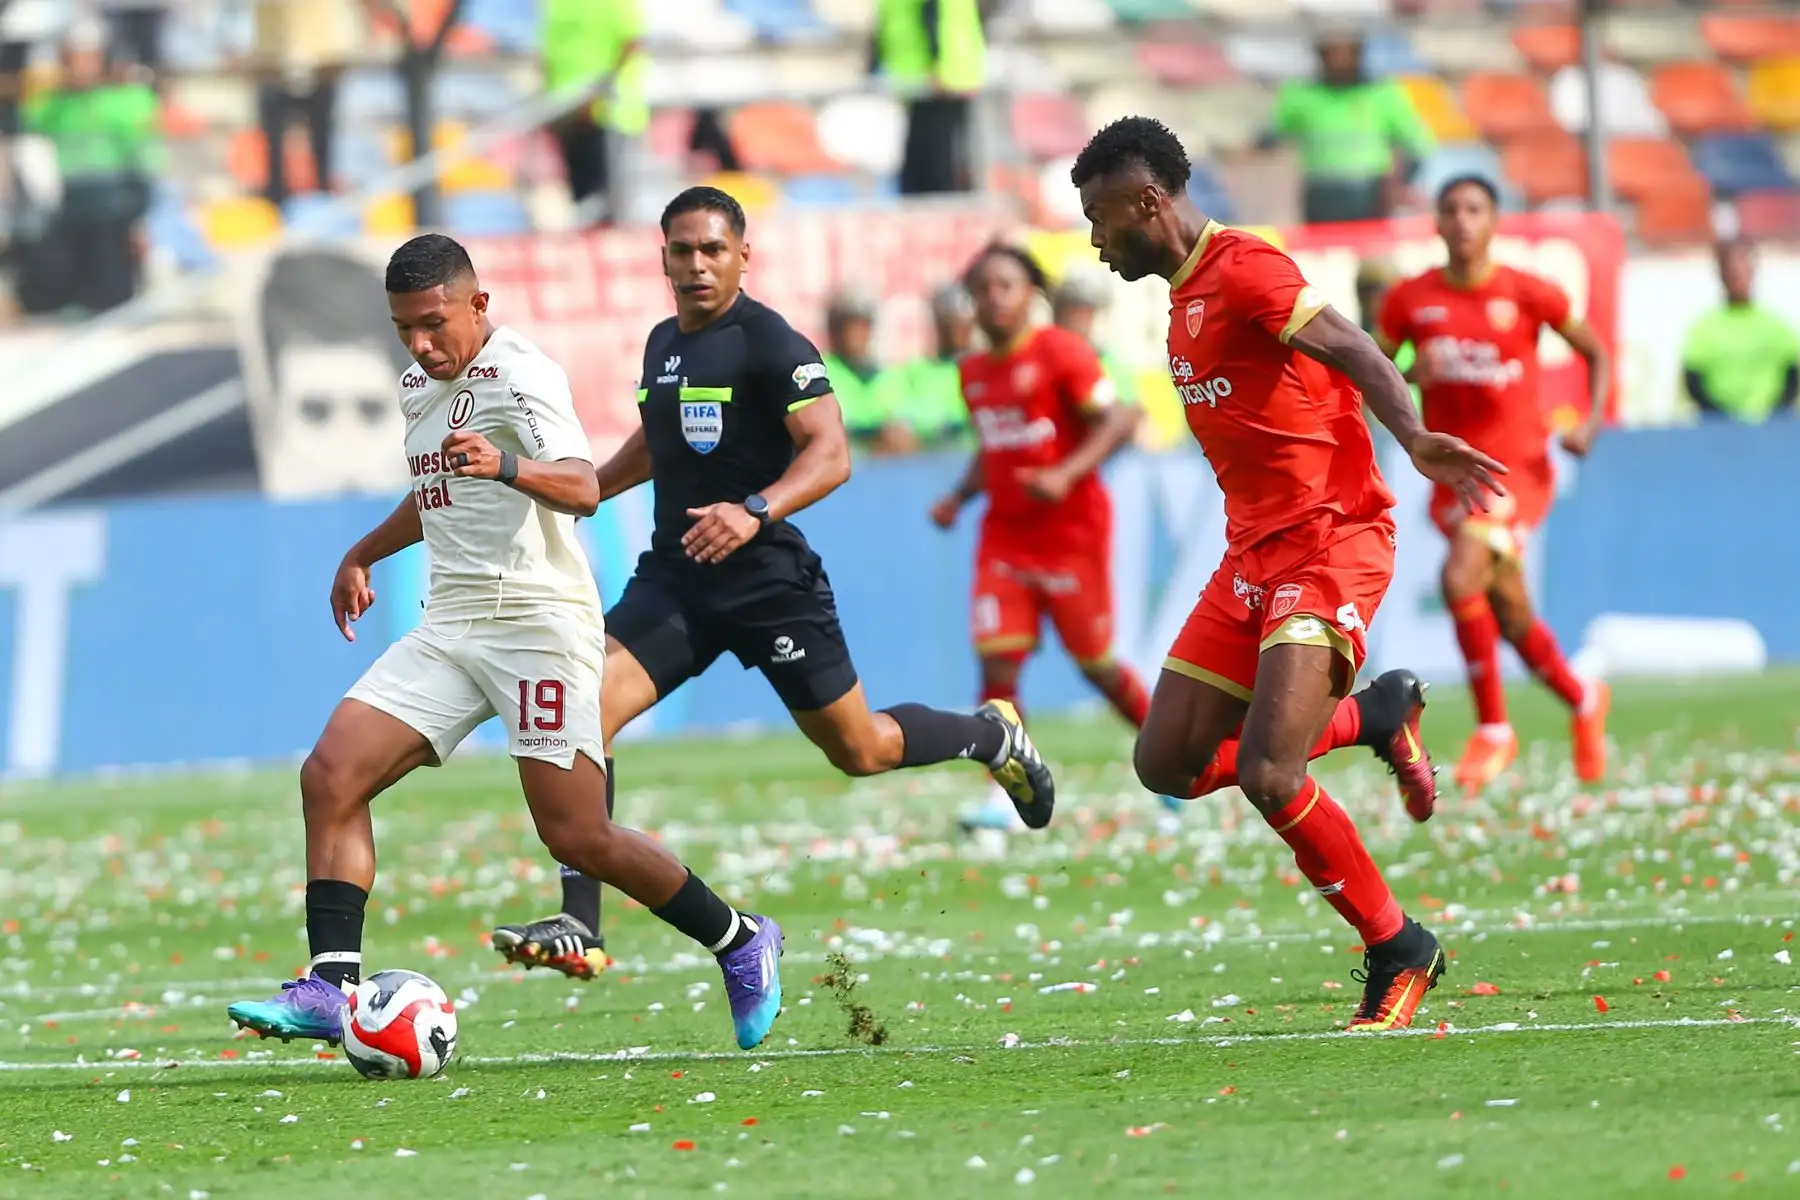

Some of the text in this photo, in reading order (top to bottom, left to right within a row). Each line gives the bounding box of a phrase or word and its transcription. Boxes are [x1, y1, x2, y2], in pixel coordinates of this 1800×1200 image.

[684, 405, 717, 418] FIFA
[508, 387, 546, 450] JETOUR
[685, 425, 718, 433] REFEREE
[518, 679, 567, 733] 19
[517, 736, 568, 748] marathon
